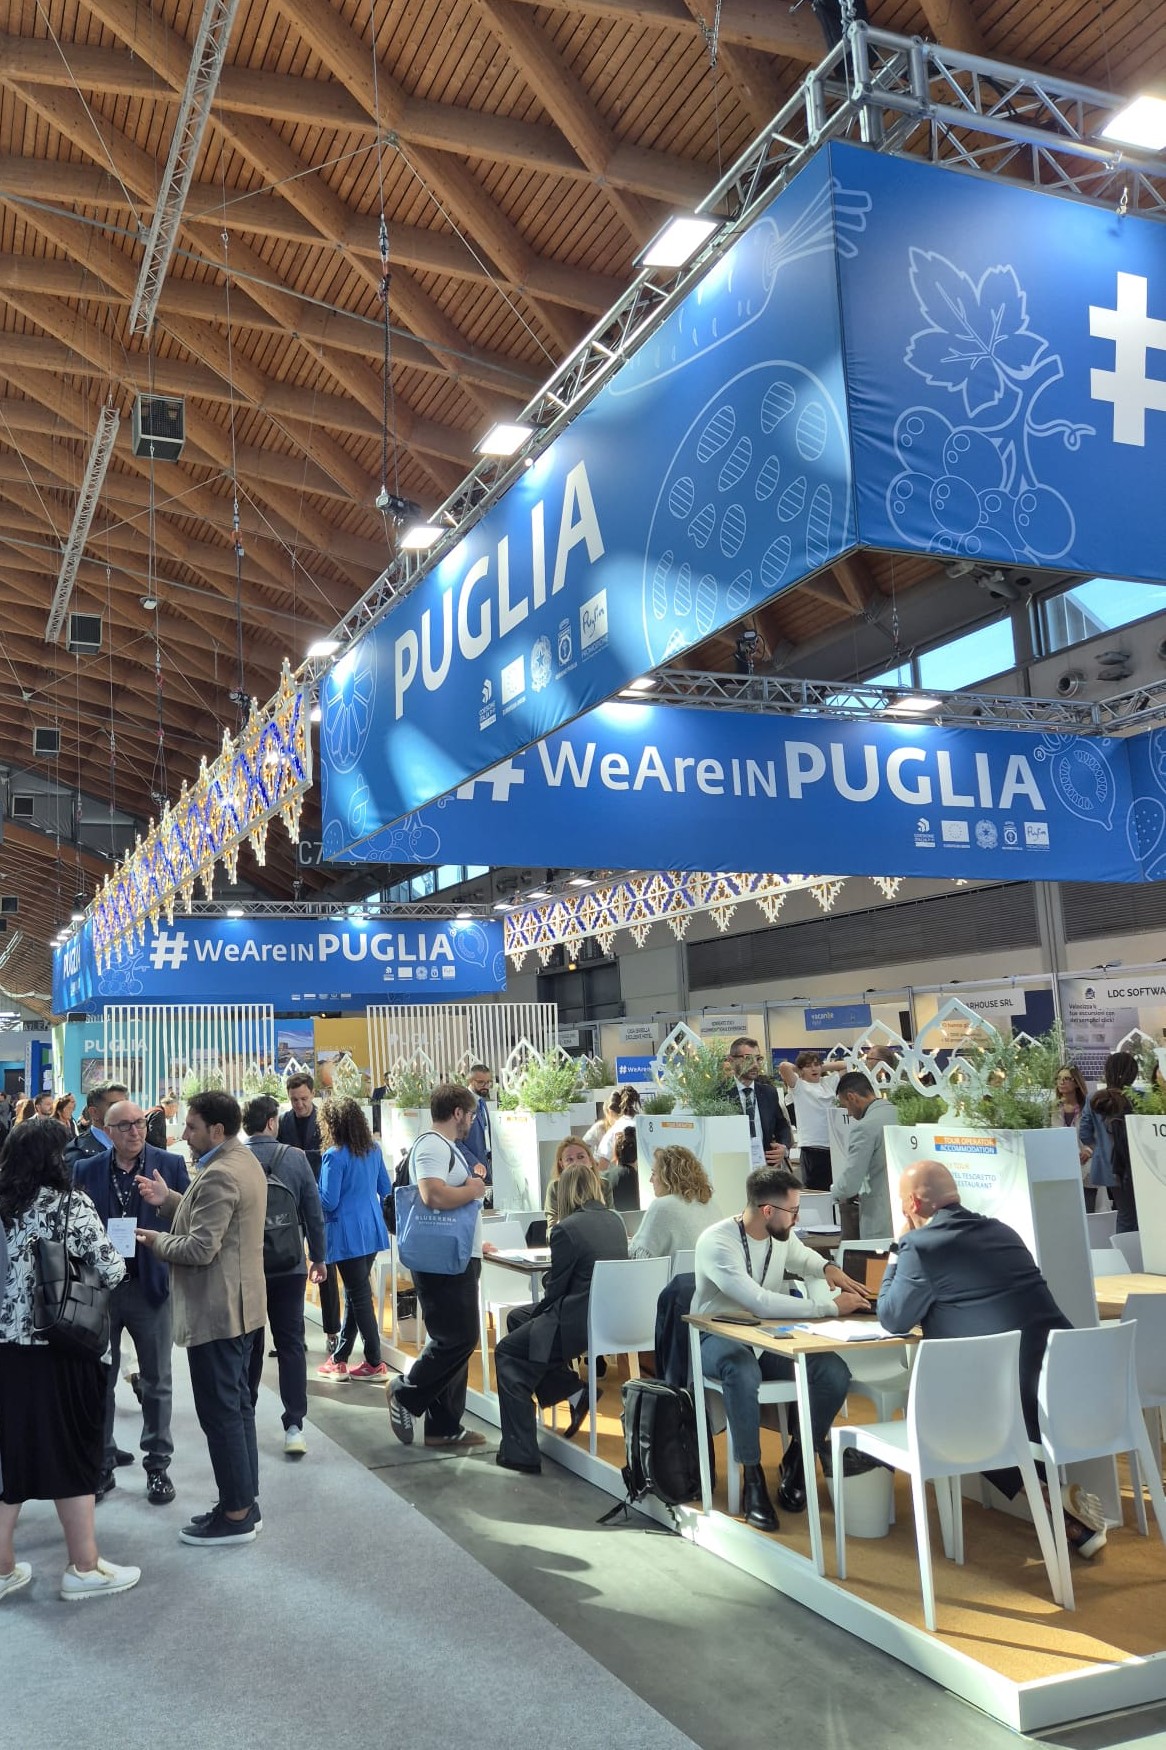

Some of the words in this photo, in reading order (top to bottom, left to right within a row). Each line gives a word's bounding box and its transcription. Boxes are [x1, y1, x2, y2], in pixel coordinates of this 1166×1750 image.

[395, 460, 605, 720] PUGLIA
[1107, 989, 1125, 998] LDC
[1127, 986, 1166, 997] SOFTWA
[1000, 998, 1014, 1007] SRL
[648, 1121, 654, 1133] 8
[910, 1135, 918, 1150] 9
[940, 1145, 995, 1154] ACCOMMODATION
[957, 1180, 993, 1189] ESTAURANT
